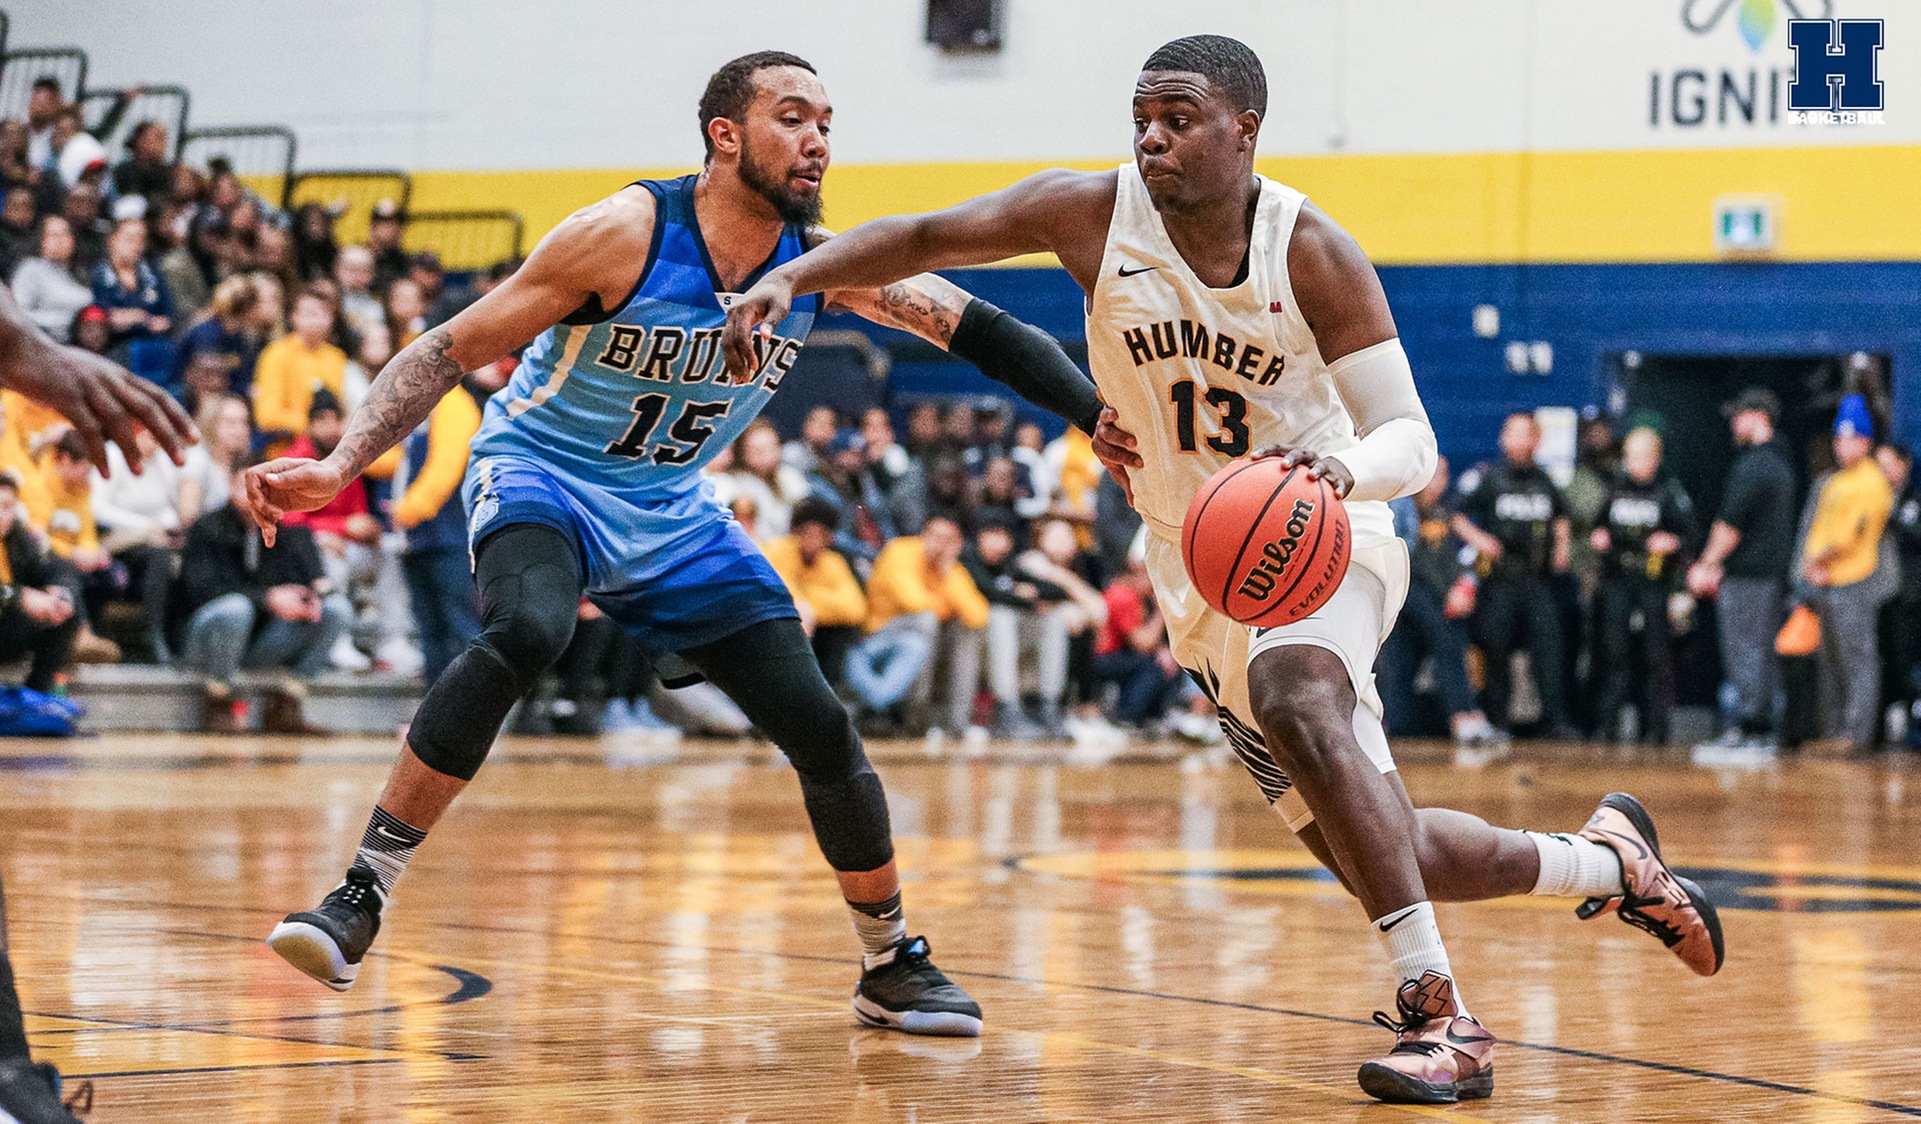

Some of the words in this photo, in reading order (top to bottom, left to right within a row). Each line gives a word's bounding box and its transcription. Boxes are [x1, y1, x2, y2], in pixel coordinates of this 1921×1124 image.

[1123, 319, 1286, 386] HUMBER
[602, 392, 734, 467] 15
[1168, 377, 1252, 460] 13
[1237, 498, 1315, 602] Wilson
[1289, 519, 1345, 616] EVOLUTION
